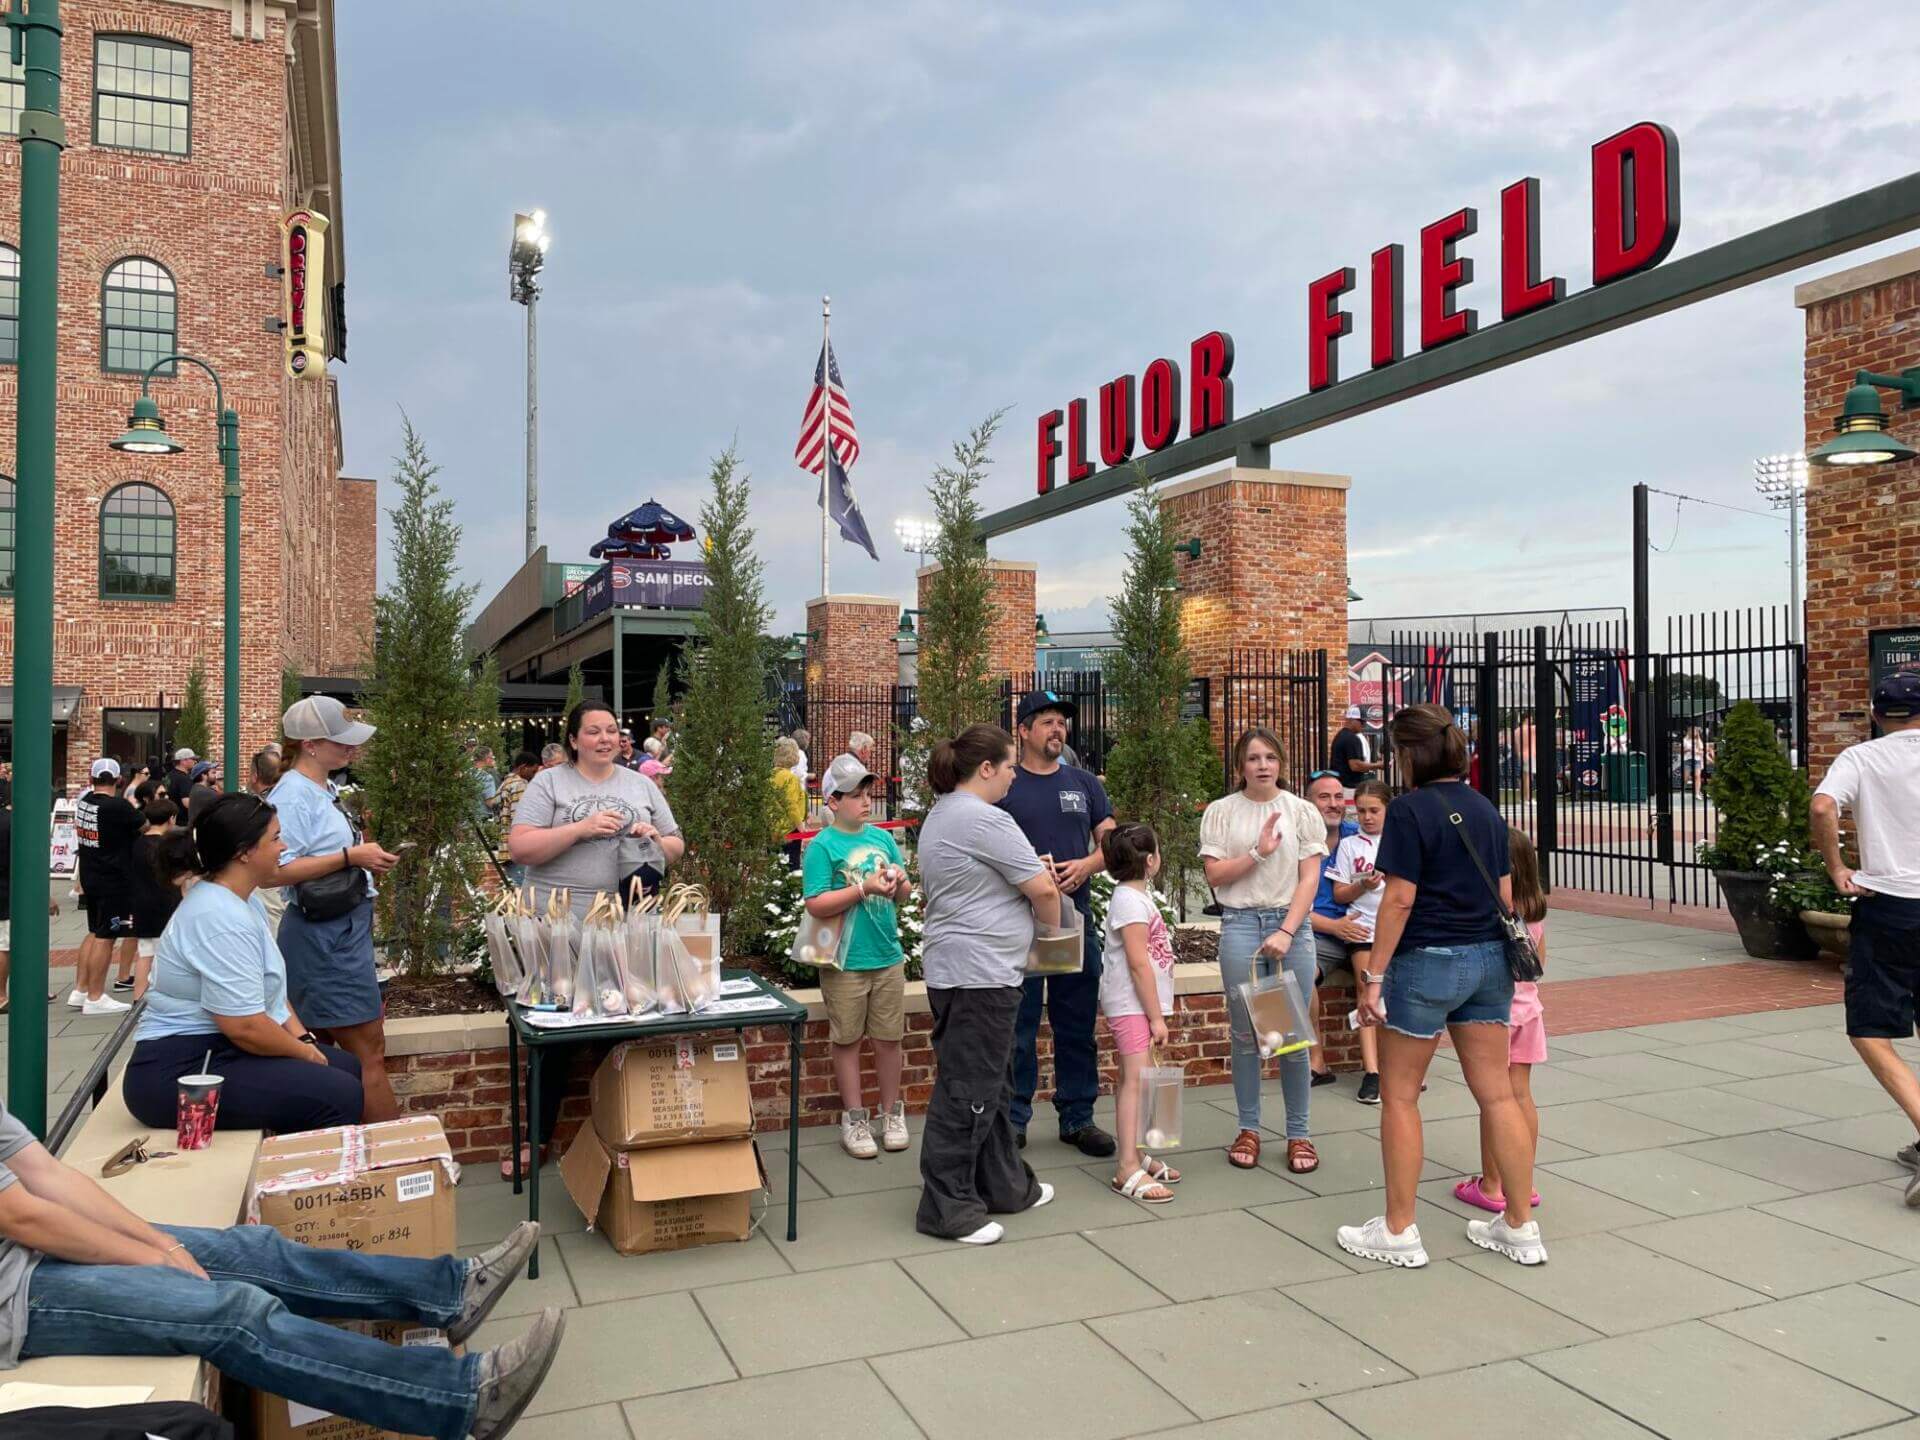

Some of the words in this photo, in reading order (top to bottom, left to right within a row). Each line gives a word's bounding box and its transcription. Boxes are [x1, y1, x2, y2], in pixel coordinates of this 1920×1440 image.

[1037, 331, 1234, 495] FLUOR
[1309, 121, 1680, 392] FIELD
[635, 572, 668, 584] SAM
[1886, 653, 1911, 664] FLUOR
[85, 830, 99, 840] YOU
[649, 1046, 708, 1059] 0011-BK
[654, 1121, 673, 1129] MADE
[294, 1183, 387, 1211] 0011-45BK
[294, 1220, 320, 1233] QTY:
[329, 1218, 336, 1227] 6
[654, 1214, 704, 1226] MEASUREMENT
[372, 1233, 386, 1245] OF
[388, 1225, 412, 1241] 834
[306, 1420, 361, 1437] MEASURE
